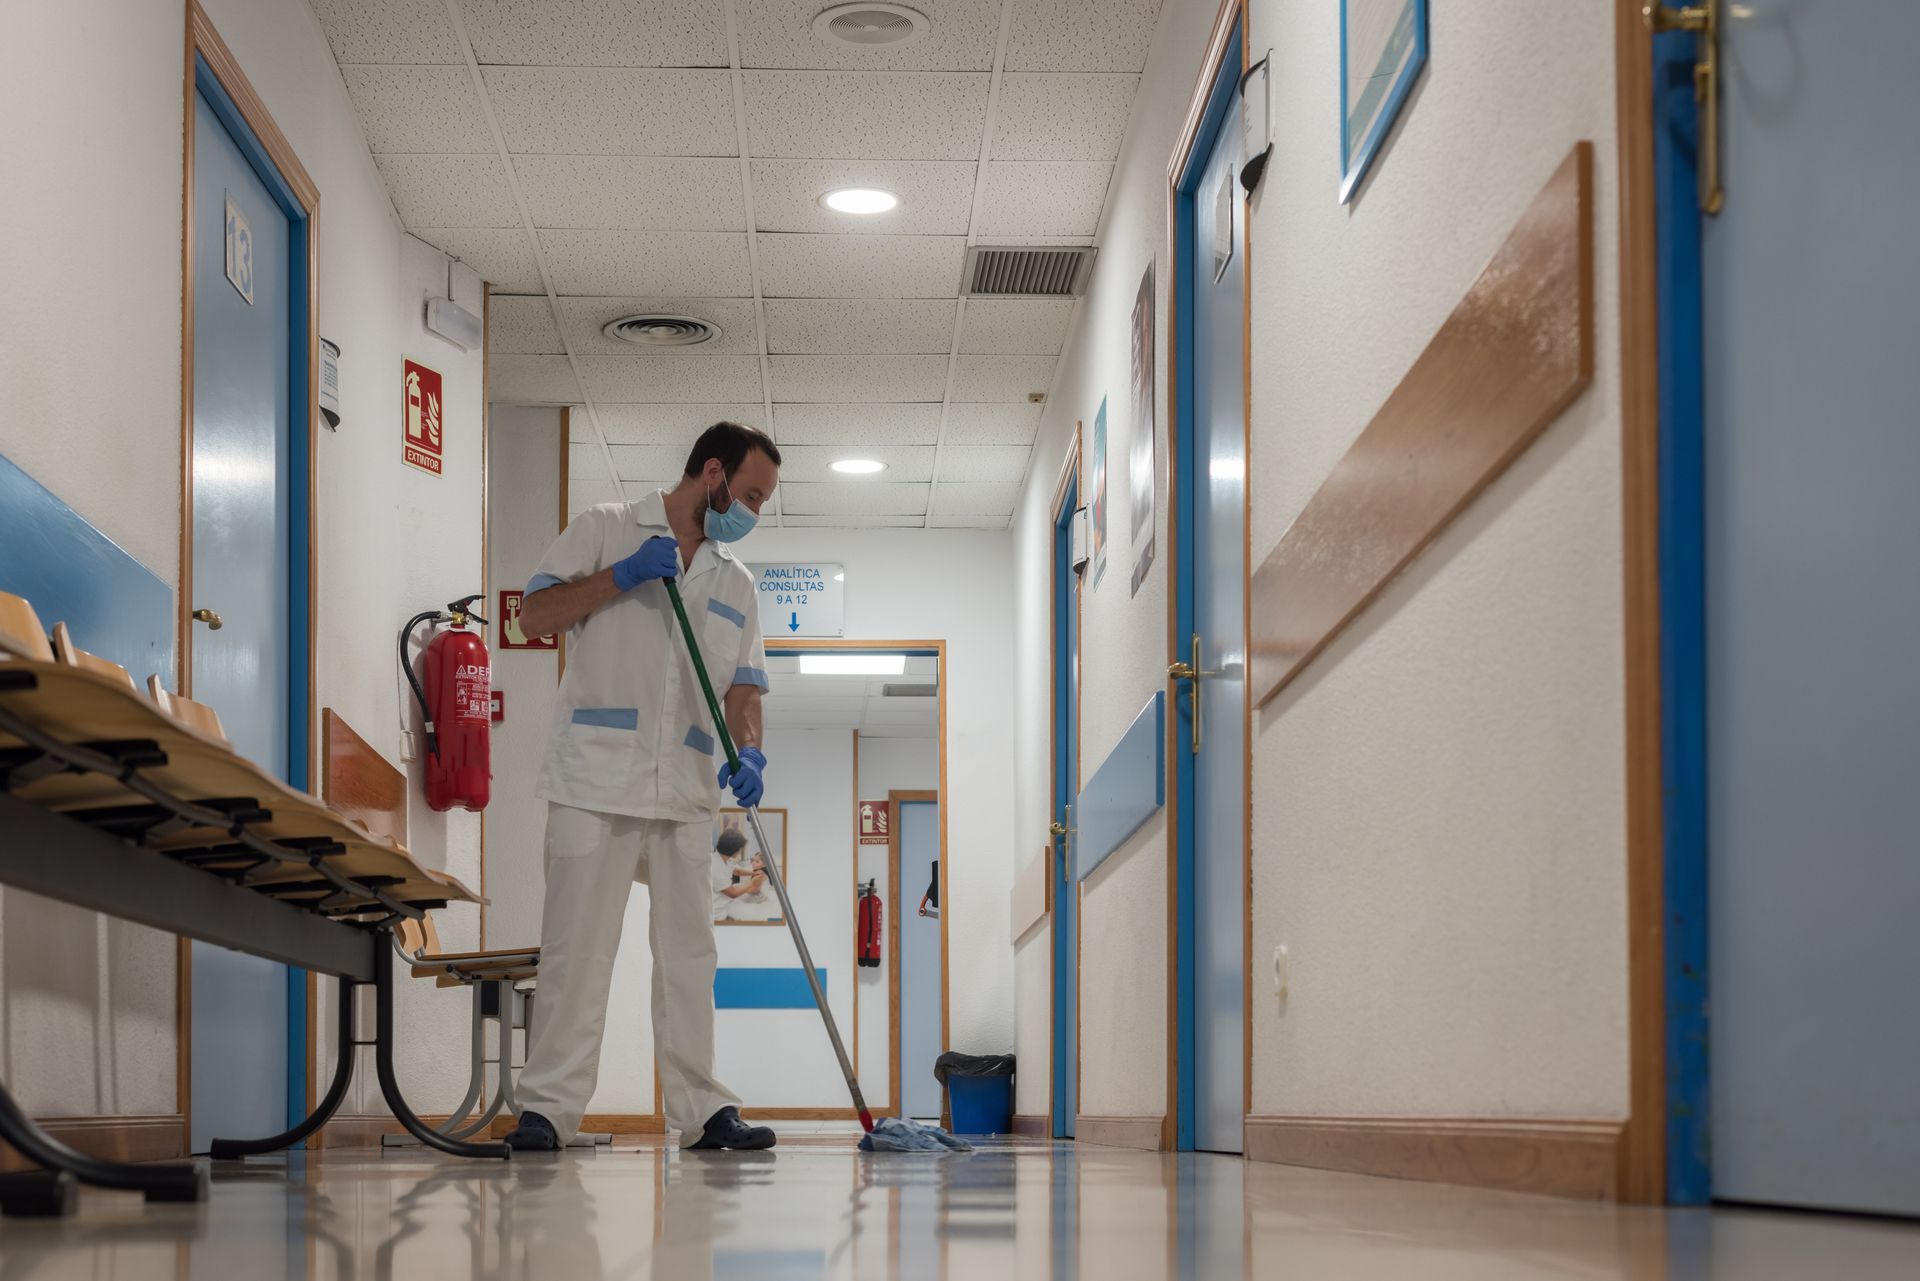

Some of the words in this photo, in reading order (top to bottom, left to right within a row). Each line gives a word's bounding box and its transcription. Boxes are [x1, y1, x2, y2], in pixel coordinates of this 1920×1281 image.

[228, 216, 250, 293] 13
[408, 450, 439, 470] EXTINTOR
[764, 567, 820, 578] ANALÍTICA
[760, 581, 824, 591] CONSULTAS
[776, 594, 783, 604] 9
[785, 594, 793, 604] A
[796, 594, 807, 604] 12
